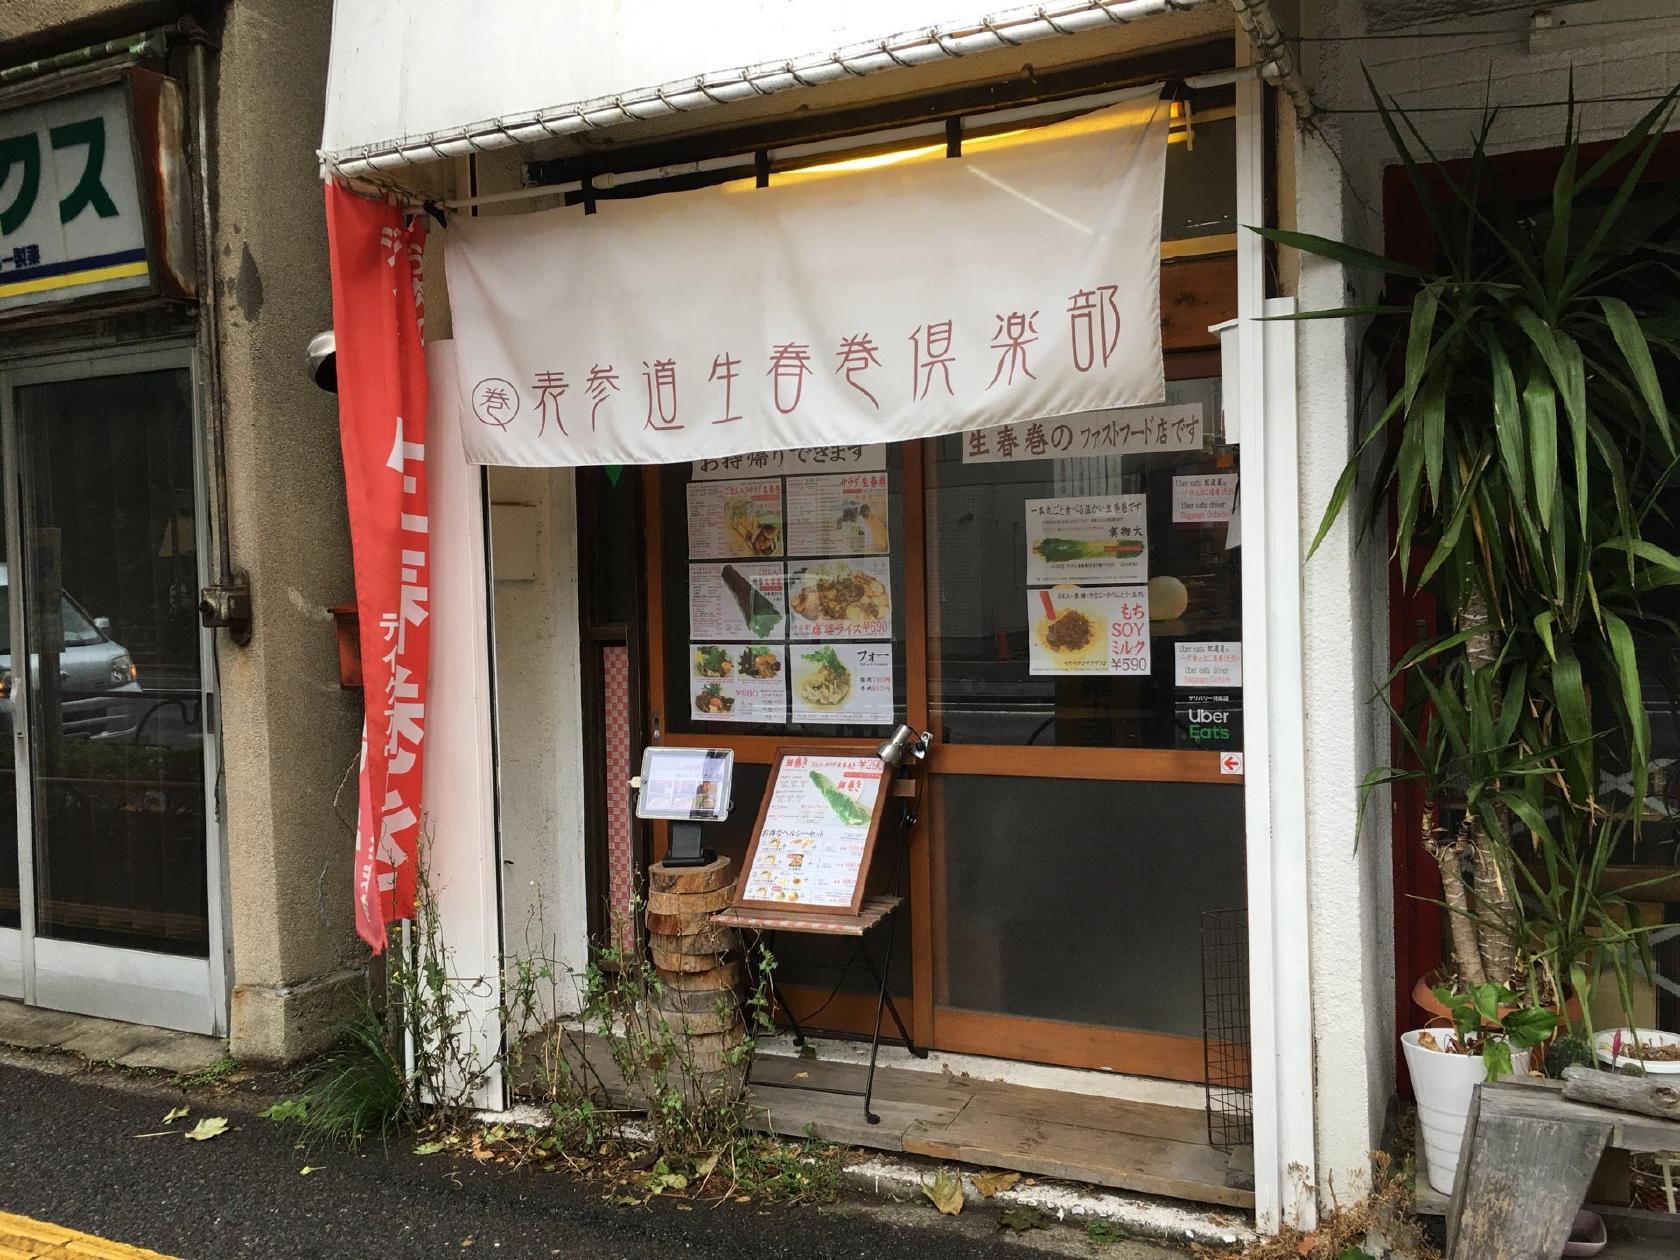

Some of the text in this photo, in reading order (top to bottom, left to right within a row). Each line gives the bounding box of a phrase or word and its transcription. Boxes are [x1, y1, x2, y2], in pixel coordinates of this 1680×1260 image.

[968, 422, 1073, 458] 生春巻の
[1081, 414, 1200, 450] ファストフード店です
[1121, 603, 1145, 620] もち
[1111, 622, 1145, 638] SOY
[857, 650, 890, 662] フォー
[1111, 642, 1145, 656] ミルク
[1111, 658, 1147, 671] ¥590
[1188, 709, 1230, 723] Uber
[1188, 724, 1230, 739] Eats
